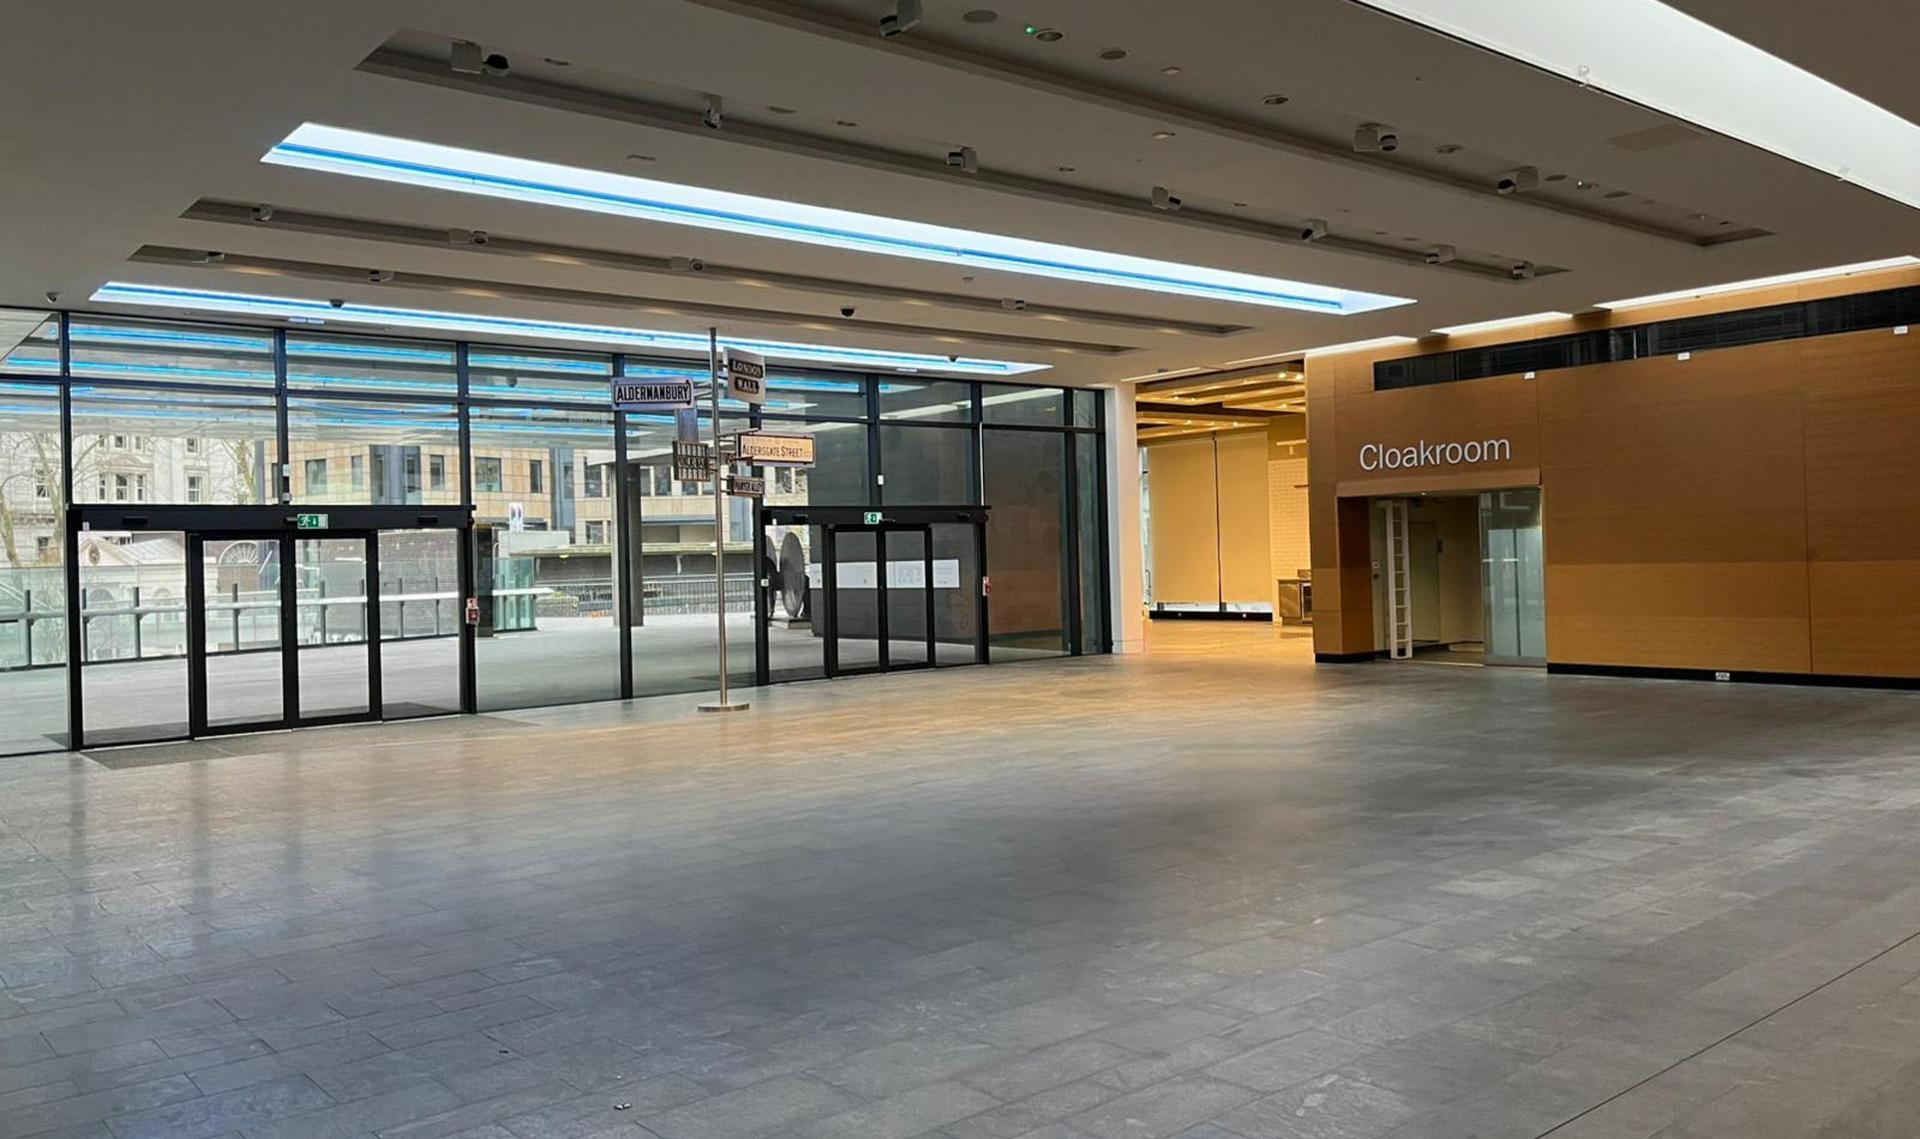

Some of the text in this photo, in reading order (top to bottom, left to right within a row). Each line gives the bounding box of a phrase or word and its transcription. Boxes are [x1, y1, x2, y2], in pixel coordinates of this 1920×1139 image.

[731, 360, 762, 377] LONDON
[617, 385, 688, 401] ALDERMANBURY
[737, 379, 757, 393] WALL
[743, 443, 780, 457] ALDERSGATE
[780, 445, 803, 458] STREET
[1359, 438, 1510, 470] Cloakroom
